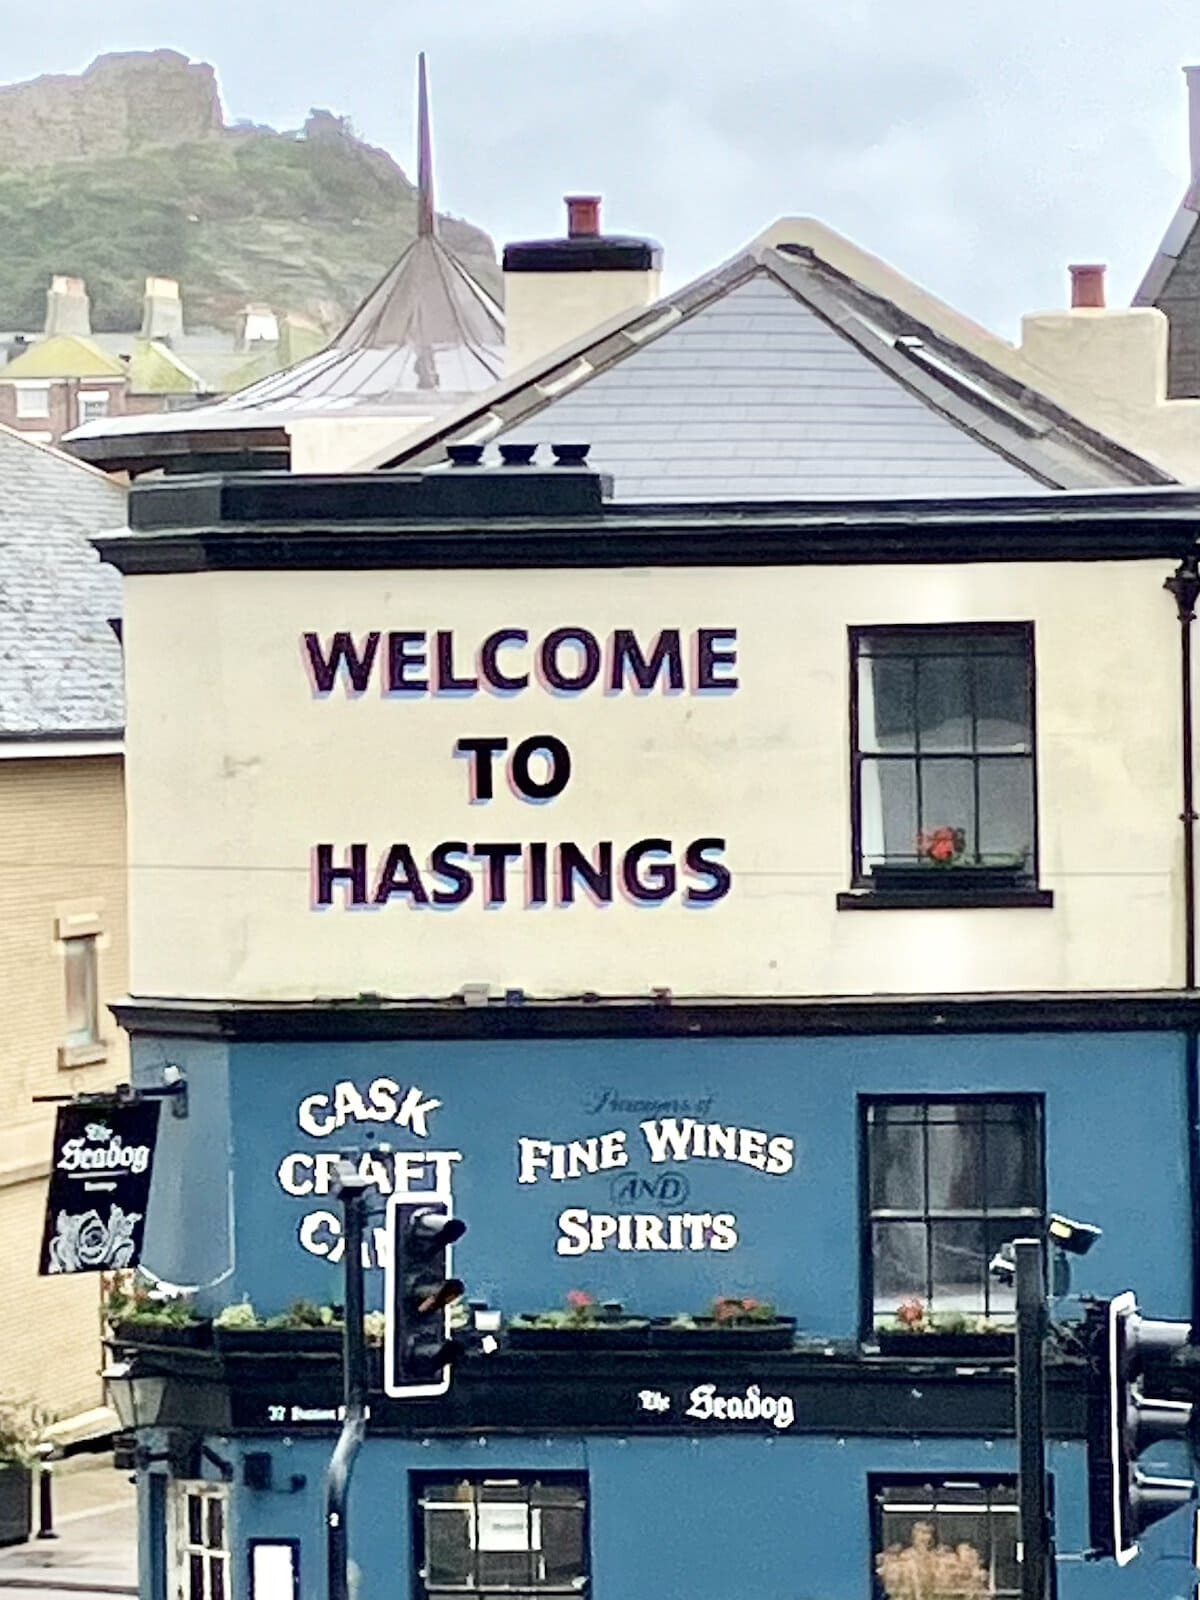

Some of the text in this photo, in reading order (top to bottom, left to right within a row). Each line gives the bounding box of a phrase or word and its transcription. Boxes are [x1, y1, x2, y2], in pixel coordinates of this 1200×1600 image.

[302, 627, 739, 698] WELCOME
[453, 734, 572, 804] TO
[310, 838, 731, 910] HASTINGS
[299, 1078, 442, 1136] CASK
[57, 1135, 150, 1174] Seadog
[518, 1117, 794, 1184] FINE WINES
[617, 1175, 683, 1202] AND
[557, 1208, 738, 1256] SPIRITS
[685, 1383, 795, 1428] Seadog
